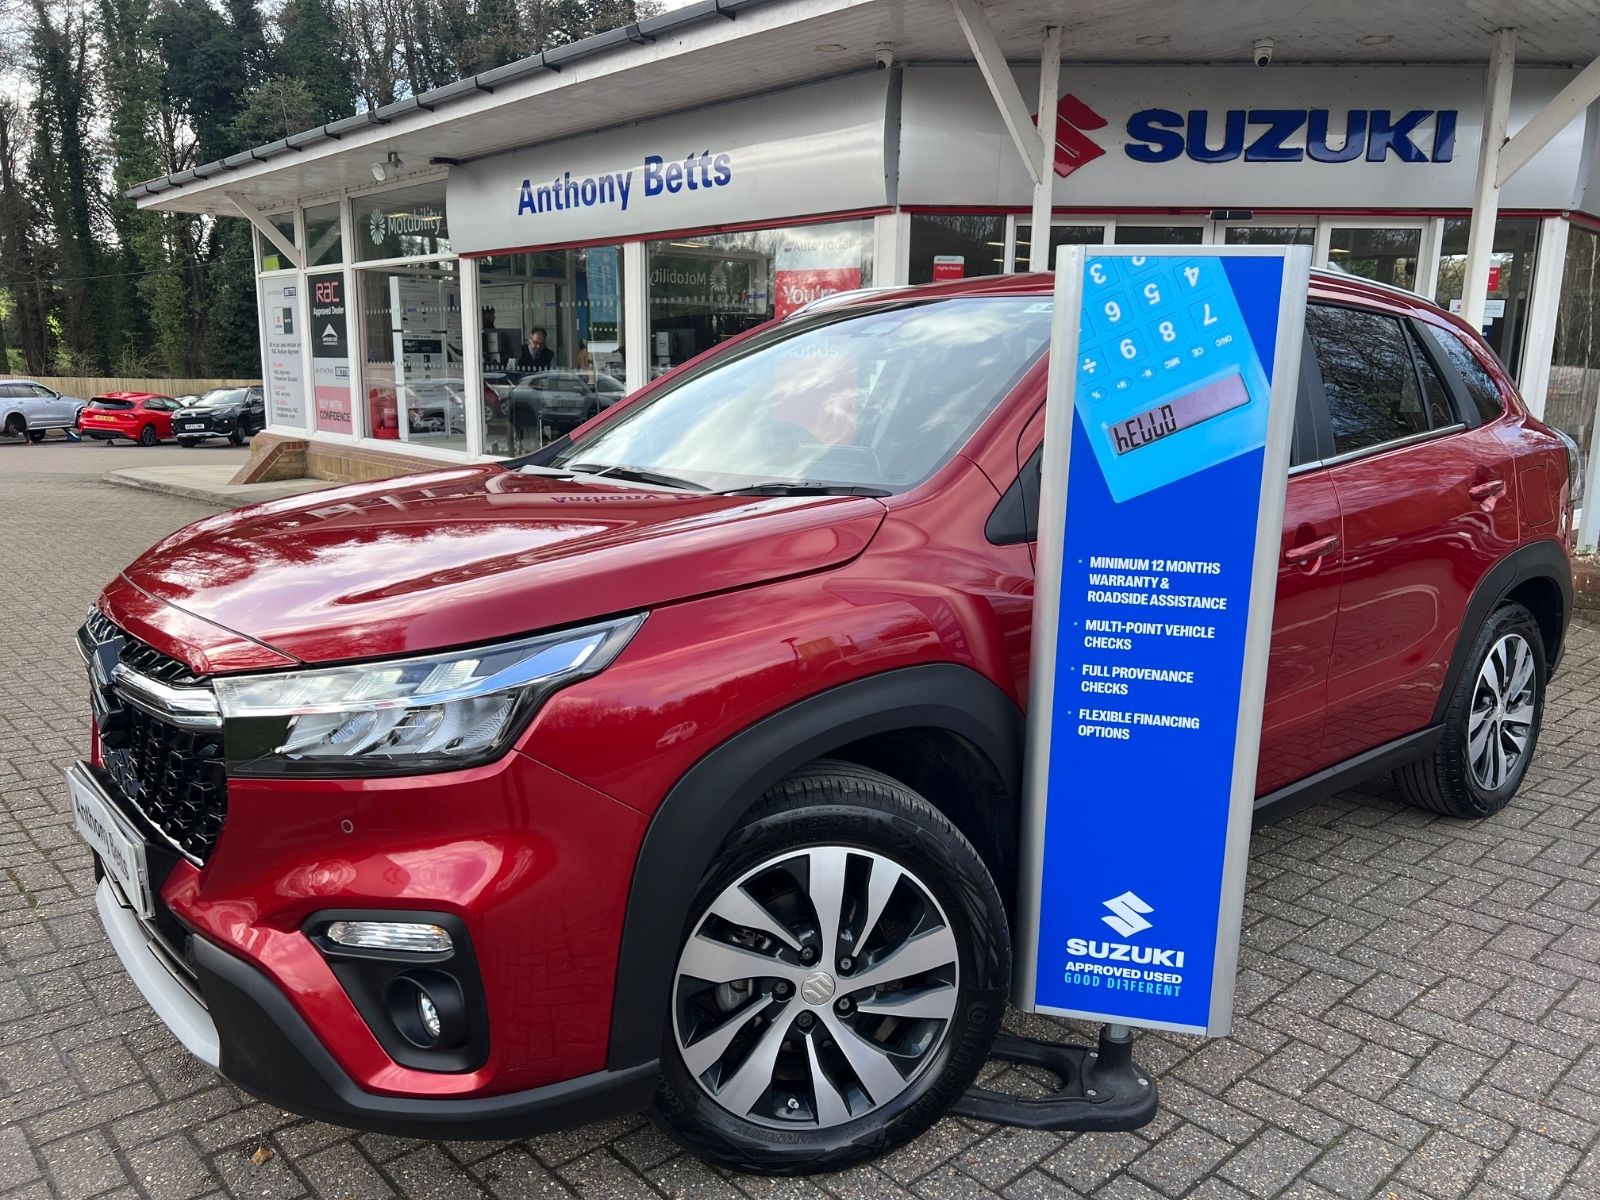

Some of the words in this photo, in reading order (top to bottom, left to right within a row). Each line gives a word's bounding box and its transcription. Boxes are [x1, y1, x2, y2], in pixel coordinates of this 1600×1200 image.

[1124, 108, 1458, 164] SUZUKI
[518, 172, 633, 216] Anthony
[644, 149, 732, 197] Betts
[388, 207, 441, 236] Motability
[1090, 556, 1149, 571] MINIMUM
[1151, 559, 1165, 572] 12
[1166, 560, 1221, 575] MONTHS
[1089, 574, 1159, 588] WARRANTY
[1160, 578, 1170, 589] &
[1087, 590, 1148, 606] ROADSIDE
[1150, 594, 1227, 610] ASSISTANCE
[1085, 619, 1163, 635] MULTI-POINT
[1165, 624, 1216, 639] VEHICLE
[1084, 636, 1132, 650] CHECKS
[1082, 664, 1111, 677] FULL
[1112, 666, 1194, 683] PROVENANCE
[1081, 680, 1129, 695] CHECKS
[1079, 708, 1132, 724] FLEXIBLE
[1133, 713, 1200, 729] FINANCING
[1078, 725, 1130, 740] OPTIONS
[1066, 938, 1185, 968] SUZUKI
[1065, 961, 1141, 979] APPROVED
[1143, 971, 1183, 984] USED
[1064, 972, 1100, 987] GOOD
[1107, 977, 1181, 997] DIFFERENT
